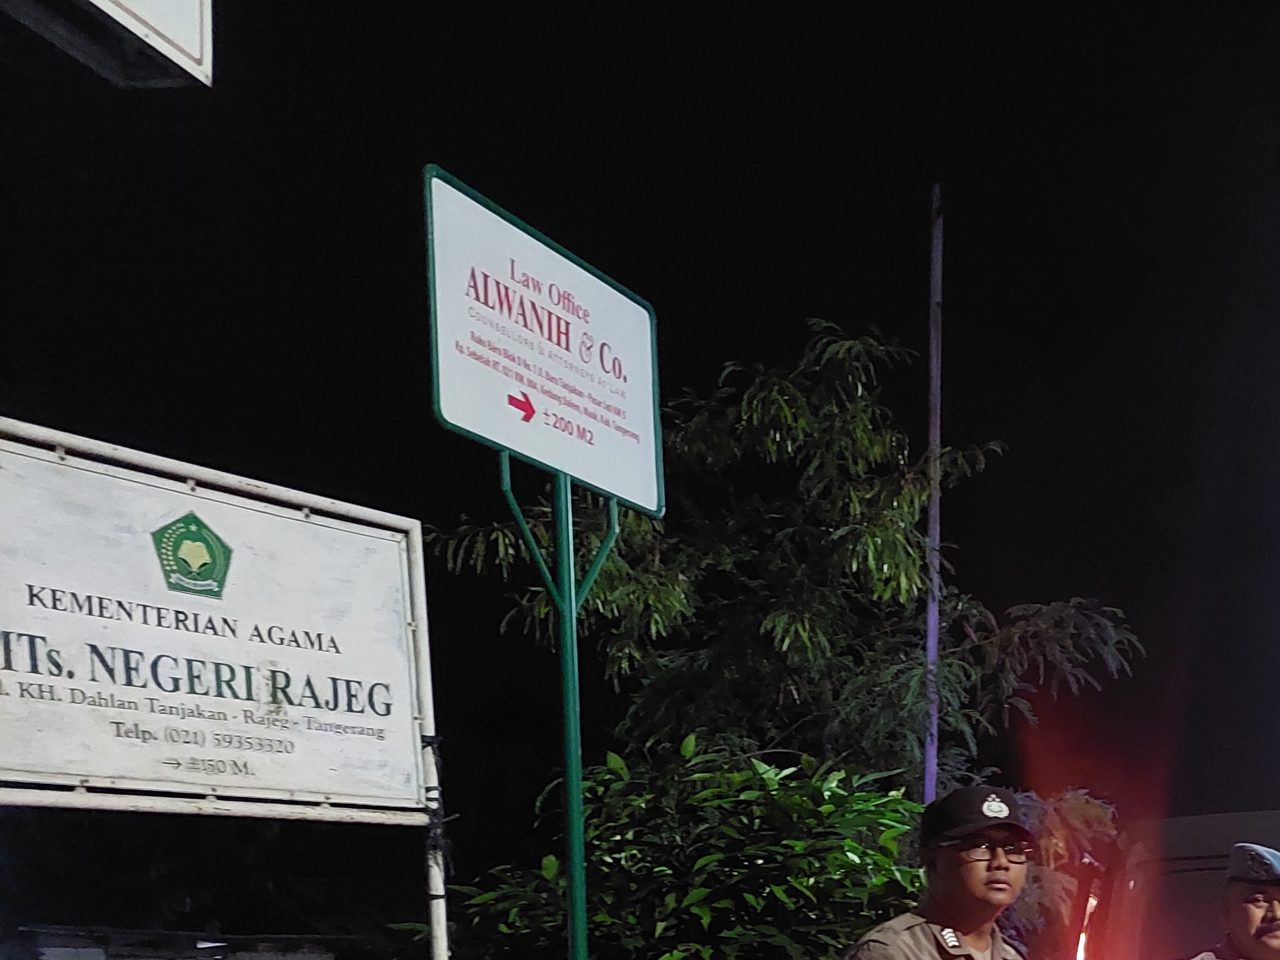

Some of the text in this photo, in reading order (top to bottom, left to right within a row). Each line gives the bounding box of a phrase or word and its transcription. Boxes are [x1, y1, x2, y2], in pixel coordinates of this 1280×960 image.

[510, 258, 590, 324] Law Office
[464, 266, 571, 353] ALWANIH
[579, 332, 594, 364] &
[600, 342, 627, 383] Co.
[576, 423, 594, 446] M2
[26, 583, 342, 655] KEMENTERIAN AGAMA
[16, 681, 63, 702] KH.
[68, 688, 139, 711] Dahlan
[144, 697, 228, 721] Tanjakan
[242, 709, 290, 729] Rajeg
[302, 715, 385, 741] Tangerang
[85, 643, 256, 701] NEGERI
[267, 669, 392, 717] RAJEG
[109, 721, 159, 744] Telp.
[164, 726, 207, 748] (021)
